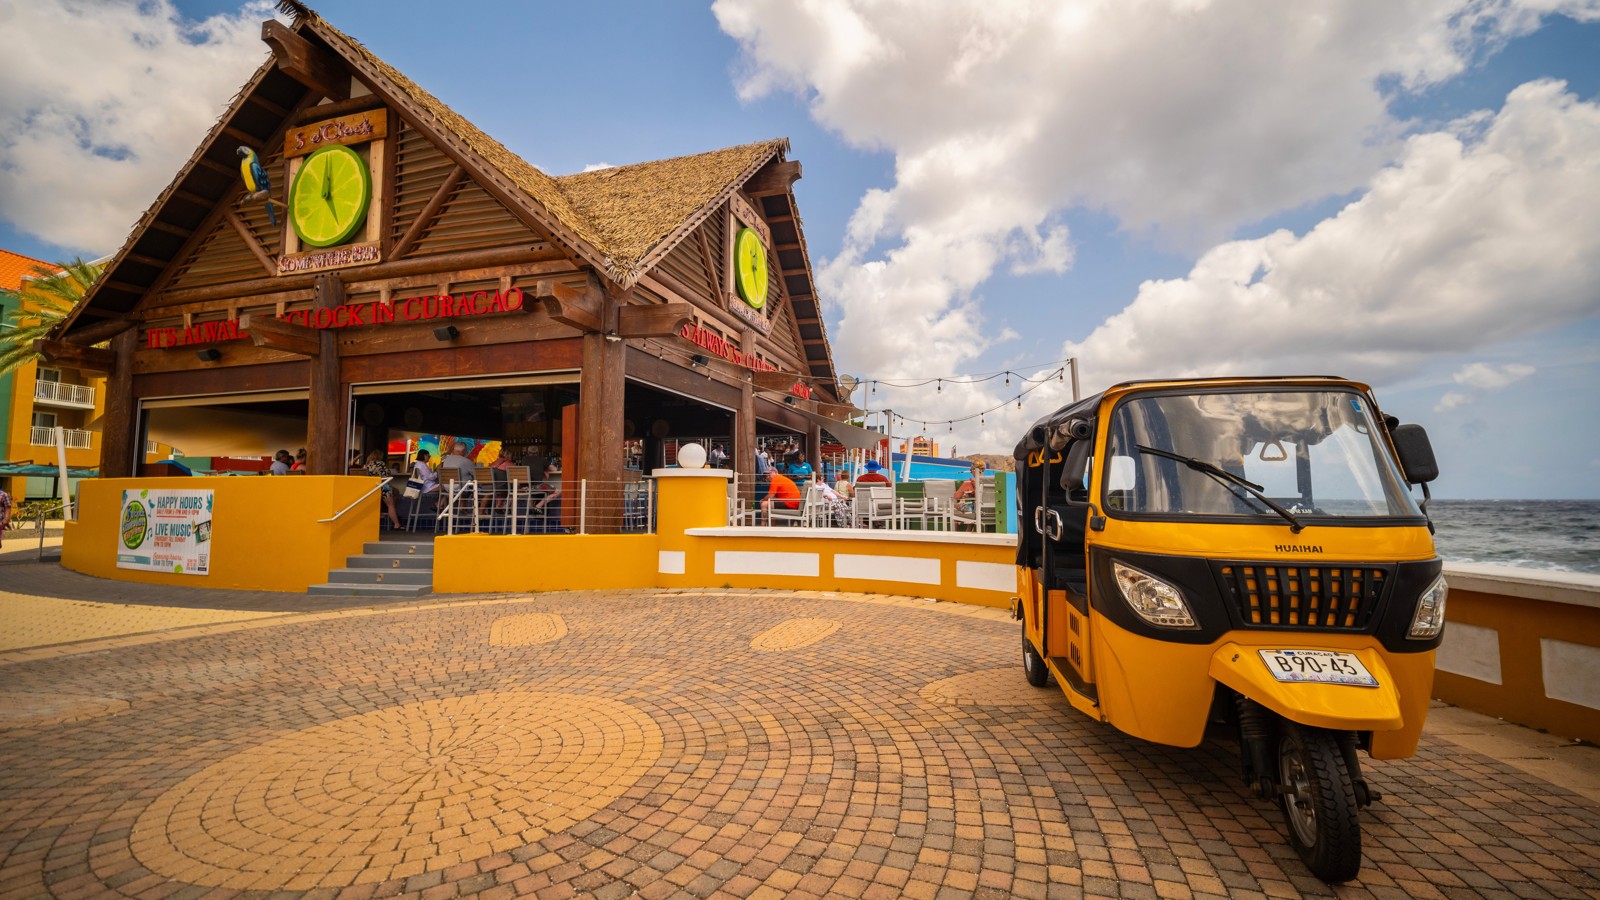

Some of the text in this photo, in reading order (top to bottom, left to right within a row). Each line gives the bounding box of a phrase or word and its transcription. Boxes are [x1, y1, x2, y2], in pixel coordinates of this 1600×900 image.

[295, 132, 304, 150] 5
[352, 246, 379, 263] BAR
[147, 327, 178, 348] IT'S
[371, 300, 395, 325] IN
[404, 287, 524, 321] CURACAO
[691, 323, 730, 361] ALWAYS
[157, 496, 203, 510] HAPPY HOURS
[154, 523, 168, 536] LIVE
[169, 523, 191, 537] MUSIC
[1275, 545, 1323, 553] HUAIHAI
[1274, 656, 1358, 676] B90-43
